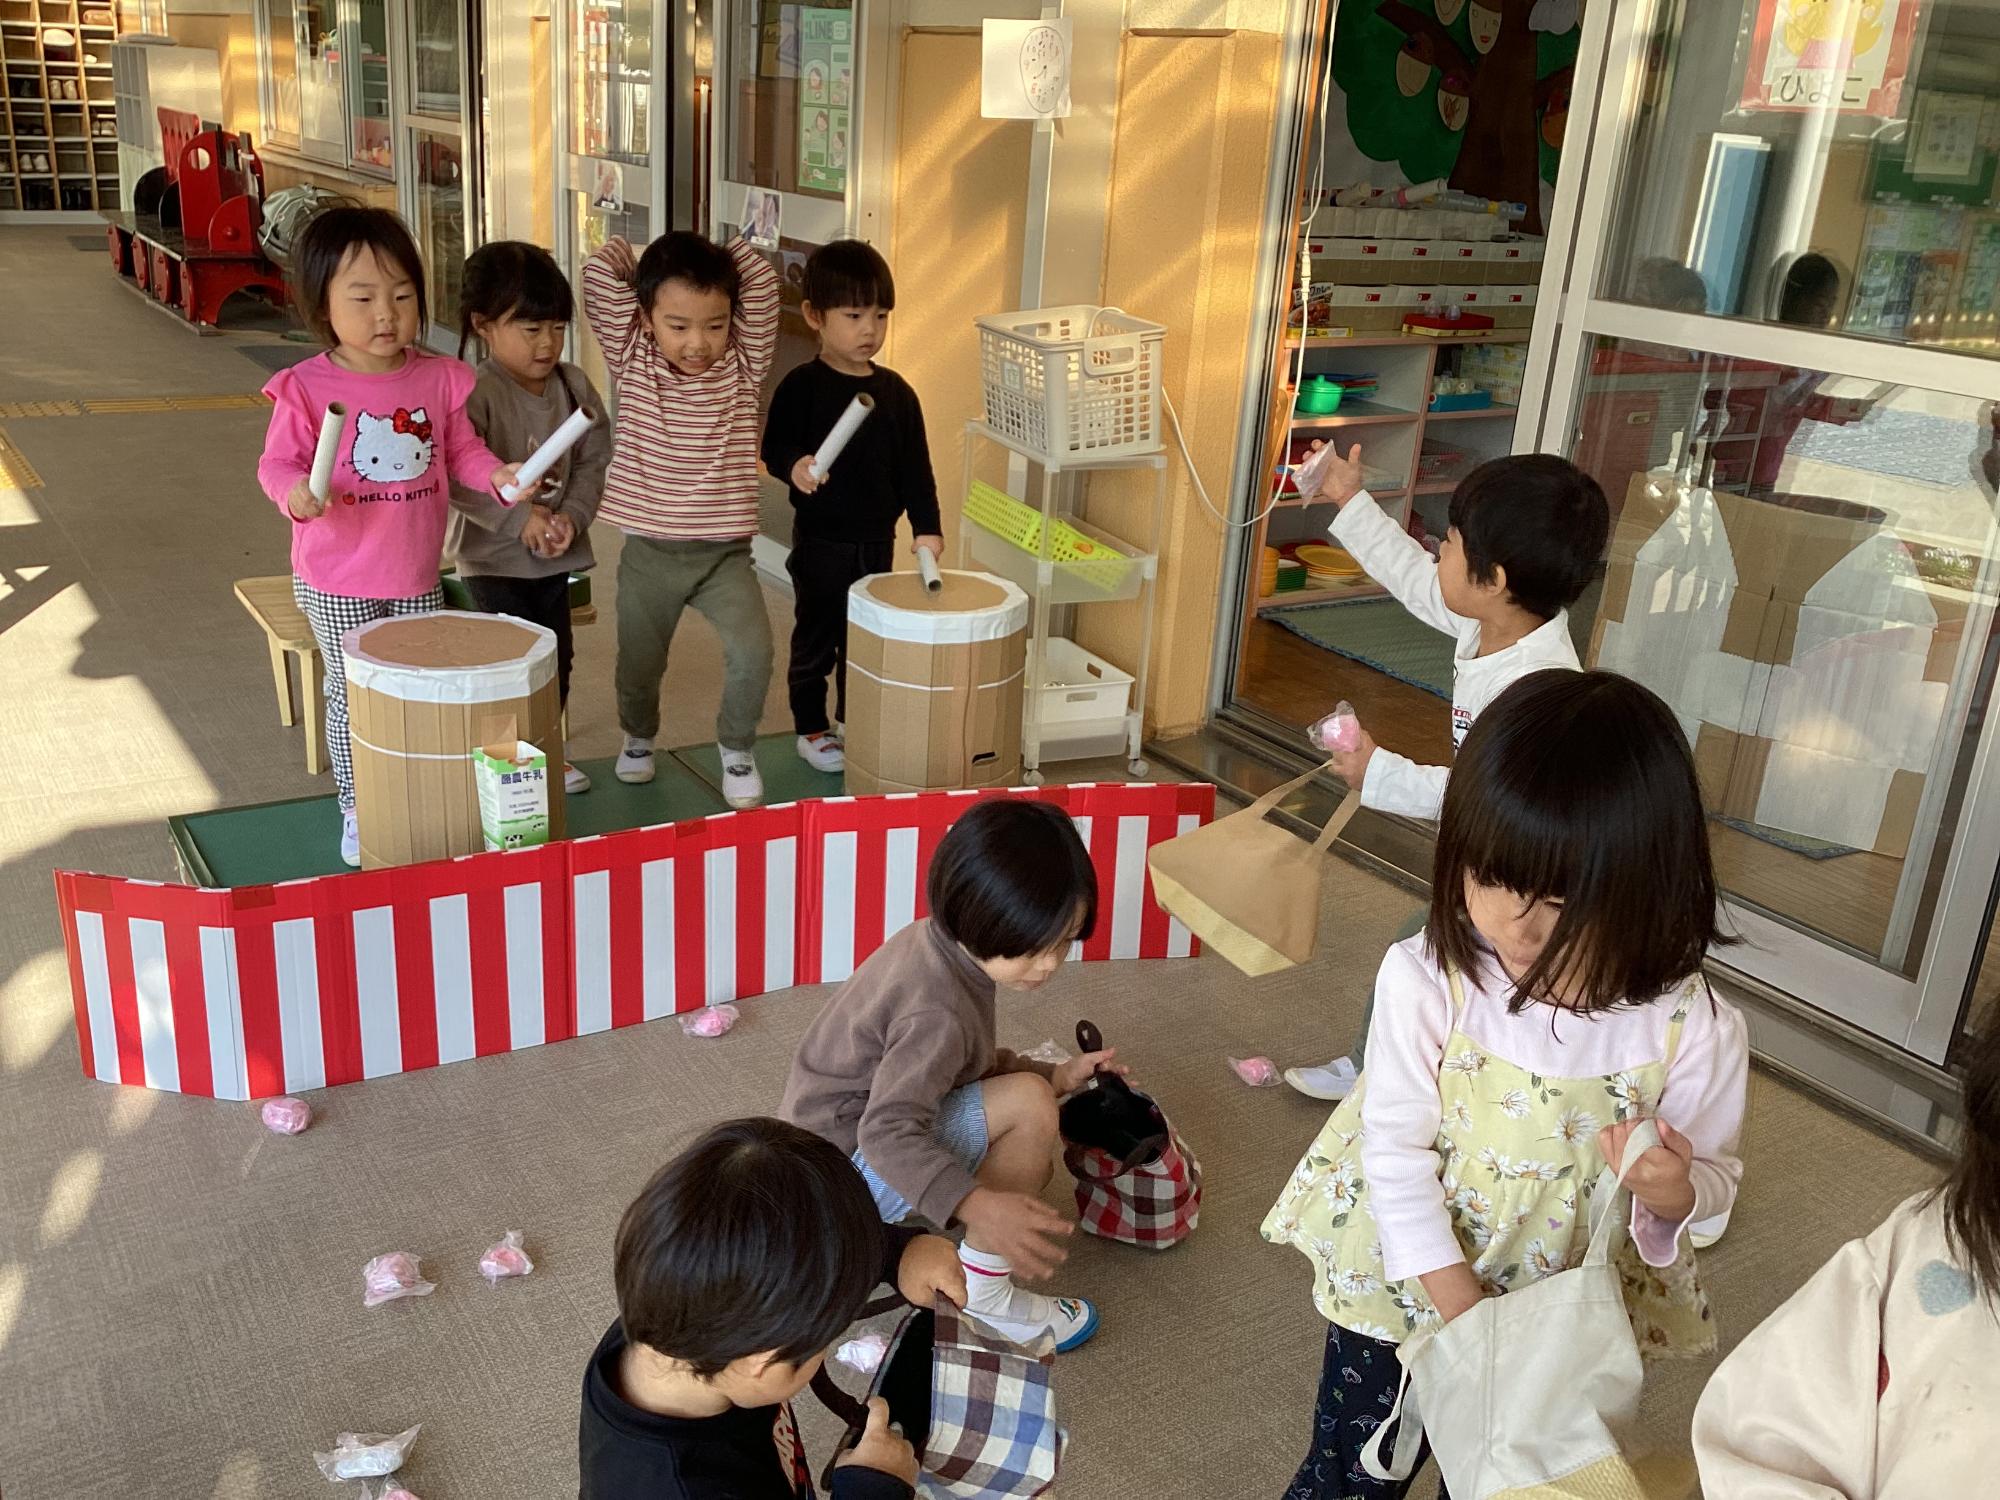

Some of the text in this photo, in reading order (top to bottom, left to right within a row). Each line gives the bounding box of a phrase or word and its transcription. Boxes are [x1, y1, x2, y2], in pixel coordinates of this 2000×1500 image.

[809, 20, 833, 39] LINE
[1780, 75, 1863, 103] ひよこ
[358, 492, 401, 504] HELLO
